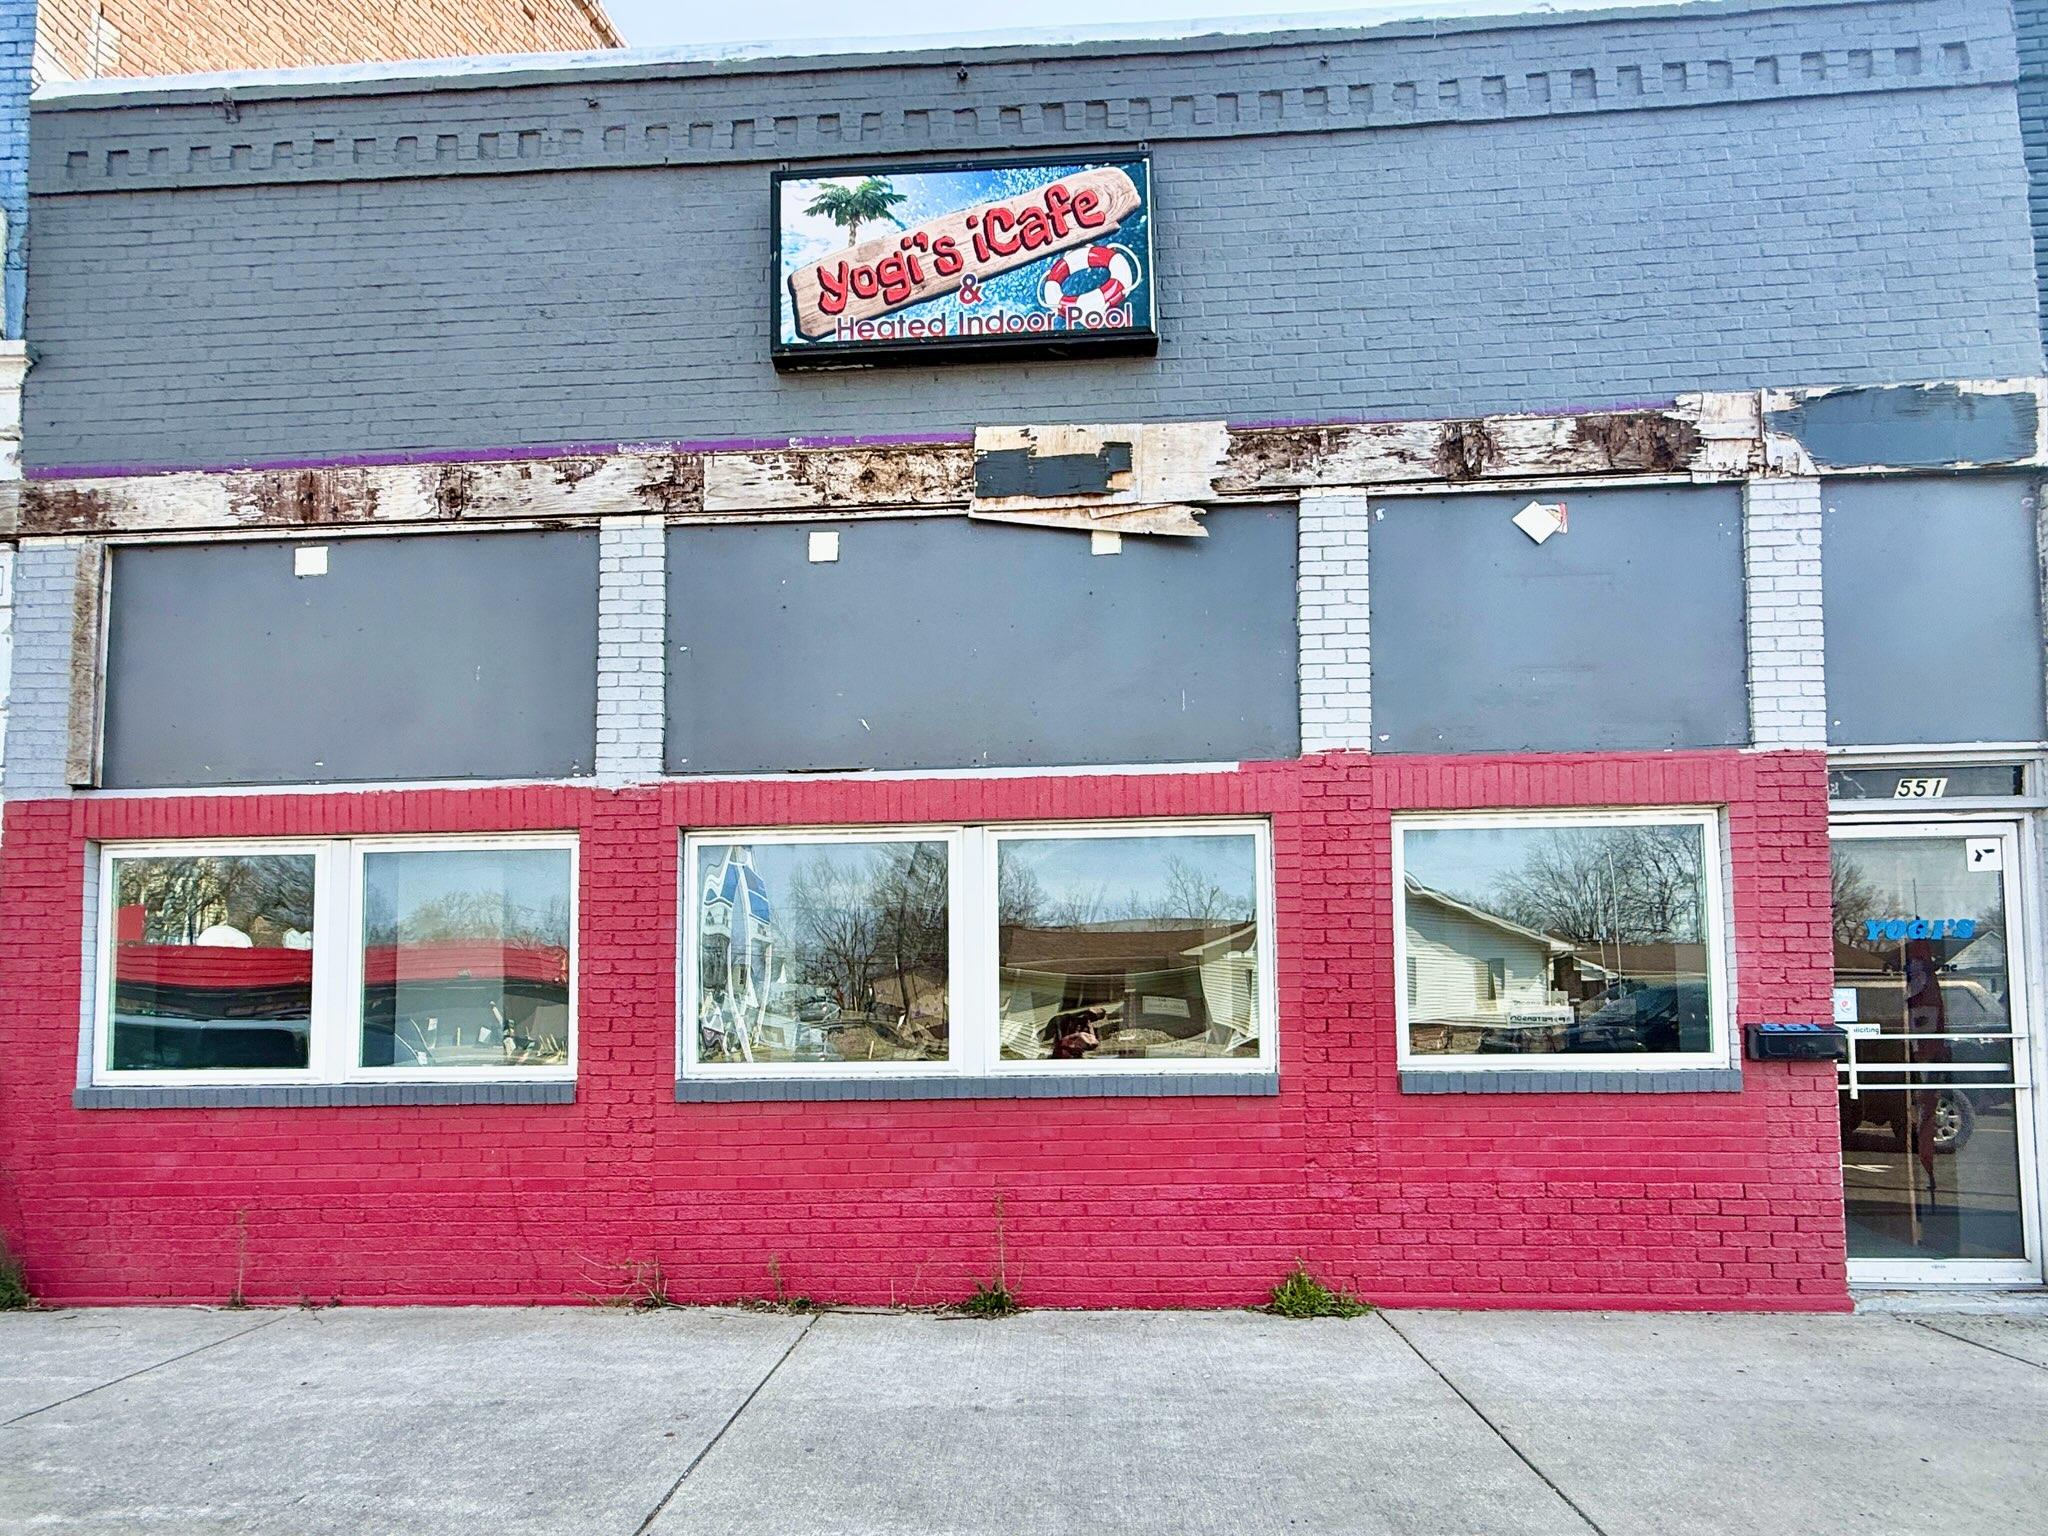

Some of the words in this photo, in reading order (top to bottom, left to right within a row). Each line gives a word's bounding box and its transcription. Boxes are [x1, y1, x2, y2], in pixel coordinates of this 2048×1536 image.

[967, 183, 1106, 262] iCafe
[959, 273, 983, 305] &
[836, 312, 946, 341] Heated
[958, 308, 1055, 334] Indoor
[1065, 303, 1133, 328] Pool
[1897, 779, 1942, 798] 551
[1864, 918, 1976, 940] YOGI'S
